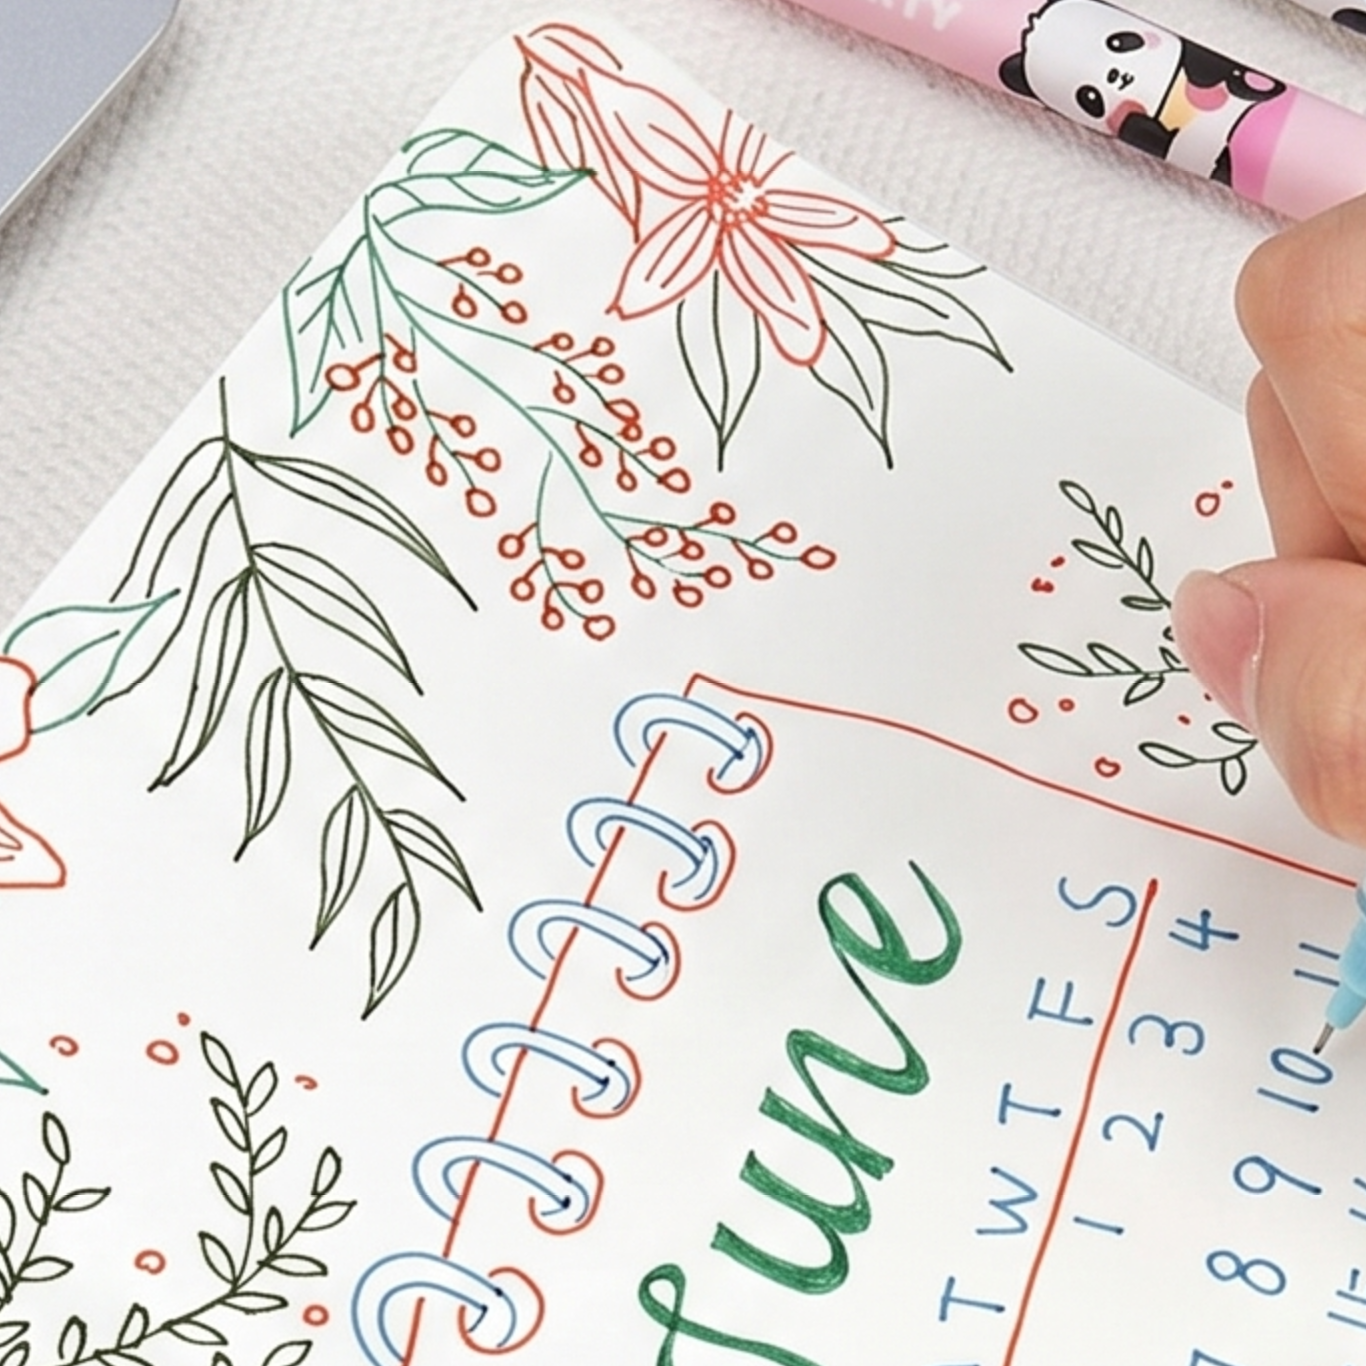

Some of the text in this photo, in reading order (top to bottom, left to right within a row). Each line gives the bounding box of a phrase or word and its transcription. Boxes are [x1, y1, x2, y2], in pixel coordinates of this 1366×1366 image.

[1058, 875, 1138, 928] S
[1027, 977, 1095, 1026] F
[1072, 909, 1240, 1236] 1 2 3 4
[1256, 1047, 1334, 1114] 10
[998, 1083, 1063, 1125] T
[1232, 1154, 1323, 1196] 9
[976, 1166, 1039, 1235] W
[1205, 1249, 1288, 1297] 8
[939, 1276, 1006, 1322] T
